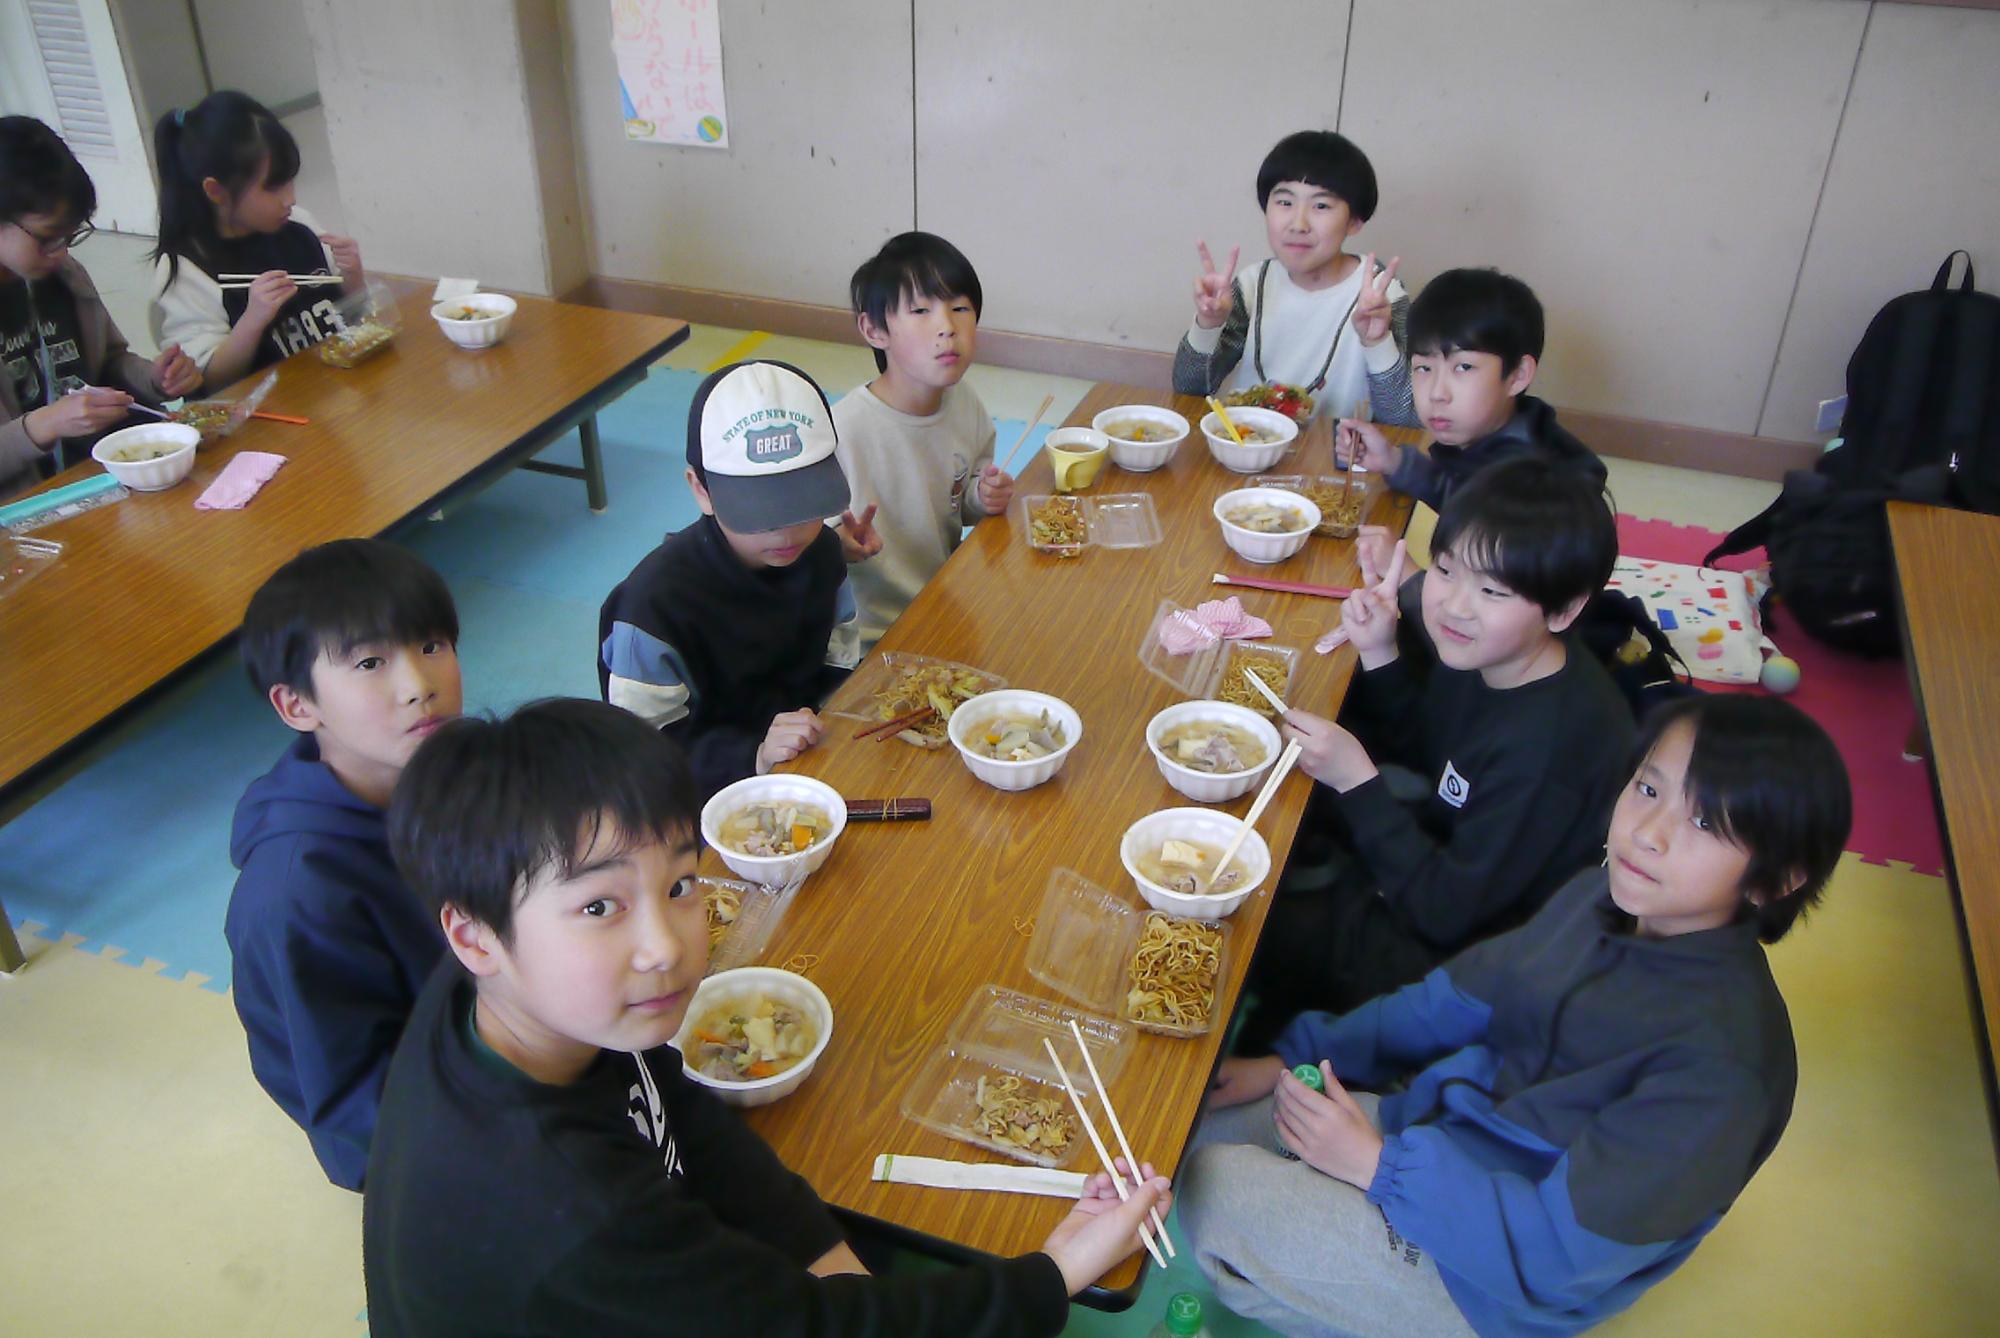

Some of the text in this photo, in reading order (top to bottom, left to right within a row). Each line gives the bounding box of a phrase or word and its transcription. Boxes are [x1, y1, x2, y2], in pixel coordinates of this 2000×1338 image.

[722, 409, 815, 442] STATE OF NEW YORK
[756, 435, 793, 455] GREAT
